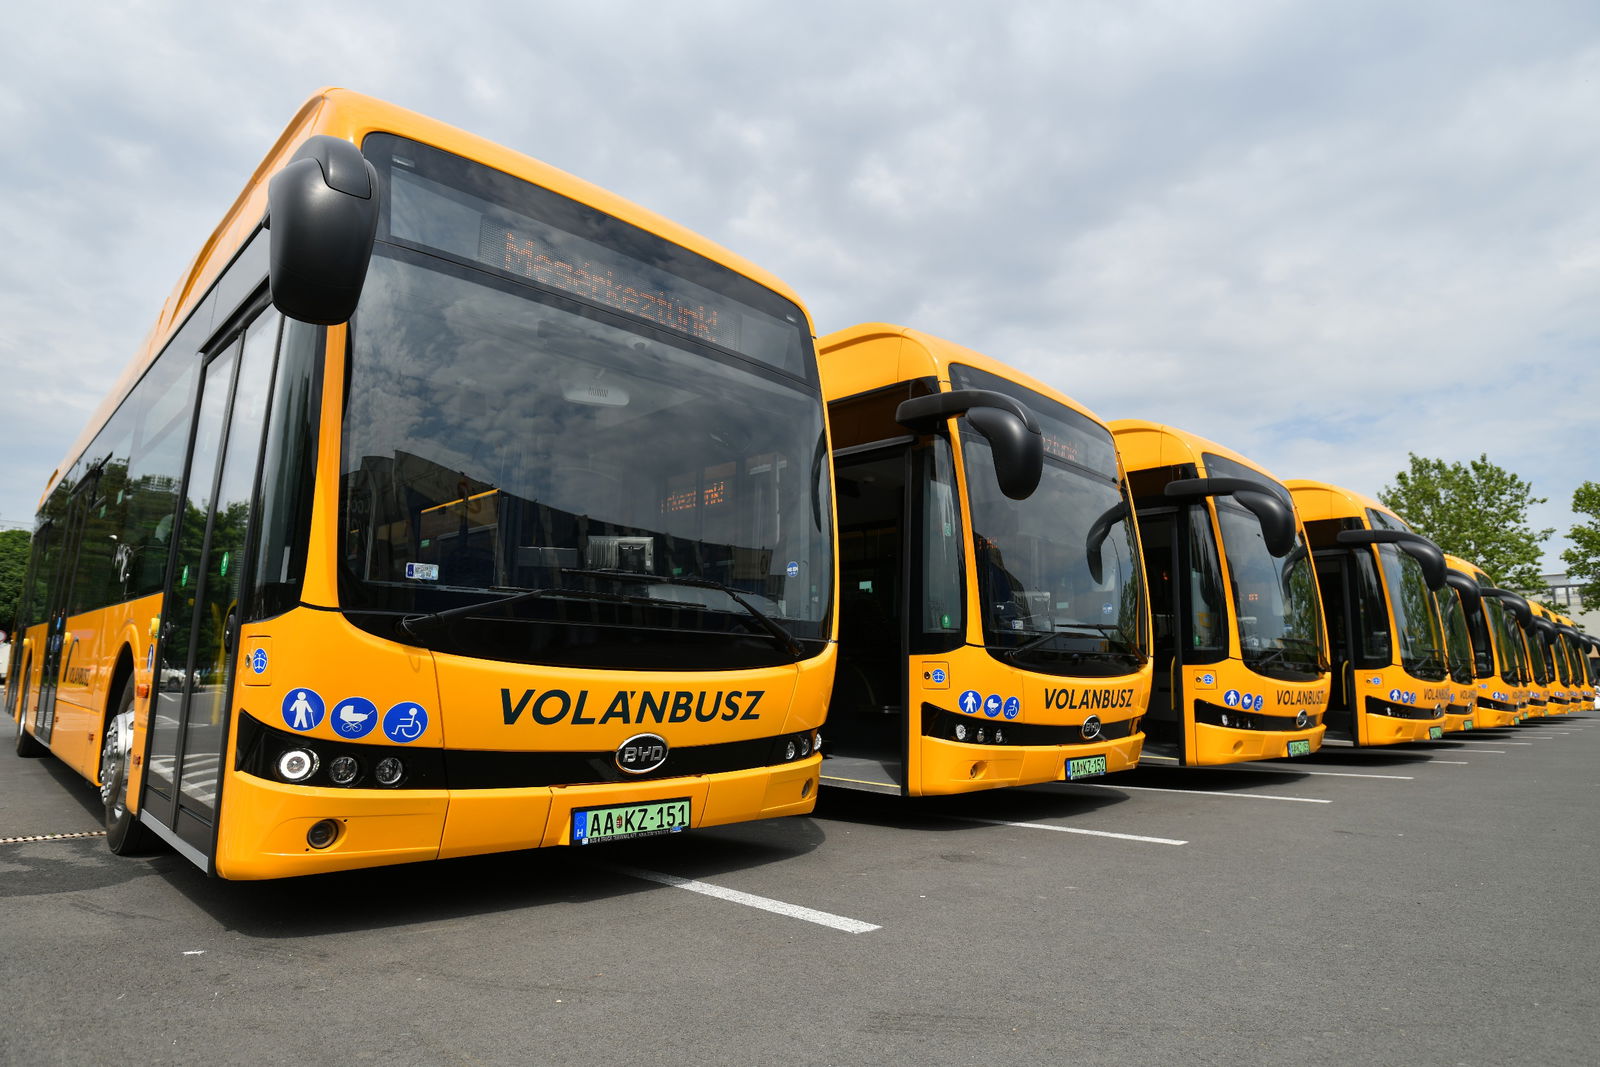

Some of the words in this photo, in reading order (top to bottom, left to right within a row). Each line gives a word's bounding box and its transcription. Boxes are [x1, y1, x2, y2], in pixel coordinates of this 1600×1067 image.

[500, 688, 765, 726] VOLÁNBUSZ
[1045, 688, 1134, 709] VOLÁNBUSZ
[623, 745, 664, 763] BYD
